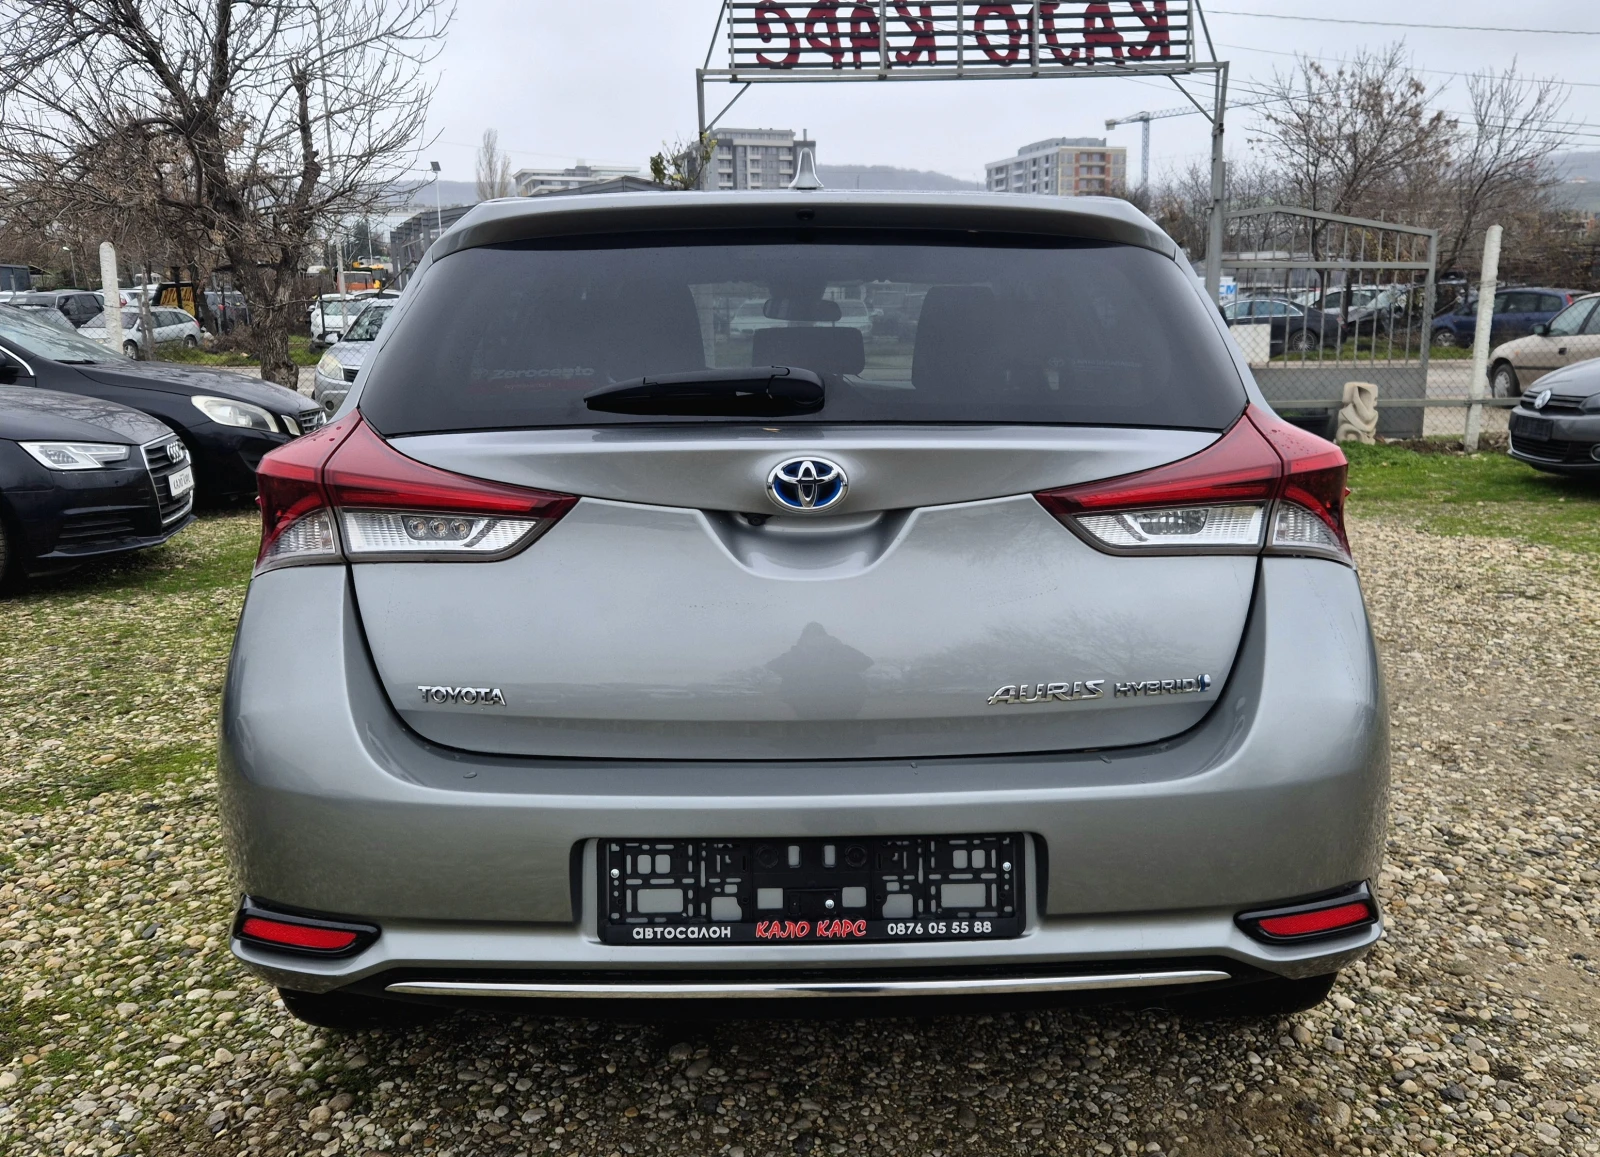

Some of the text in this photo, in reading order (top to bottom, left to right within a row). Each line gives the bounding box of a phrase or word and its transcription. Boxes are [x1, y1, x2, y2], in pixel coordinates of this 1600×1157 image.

[418, 686, 506, 706] TOYOTA
[987, 678, 1198, 705] AURIS HYBRID
[632, 919, 993, 942] автосалон КАЛО КАРС 0876 05 55 88
